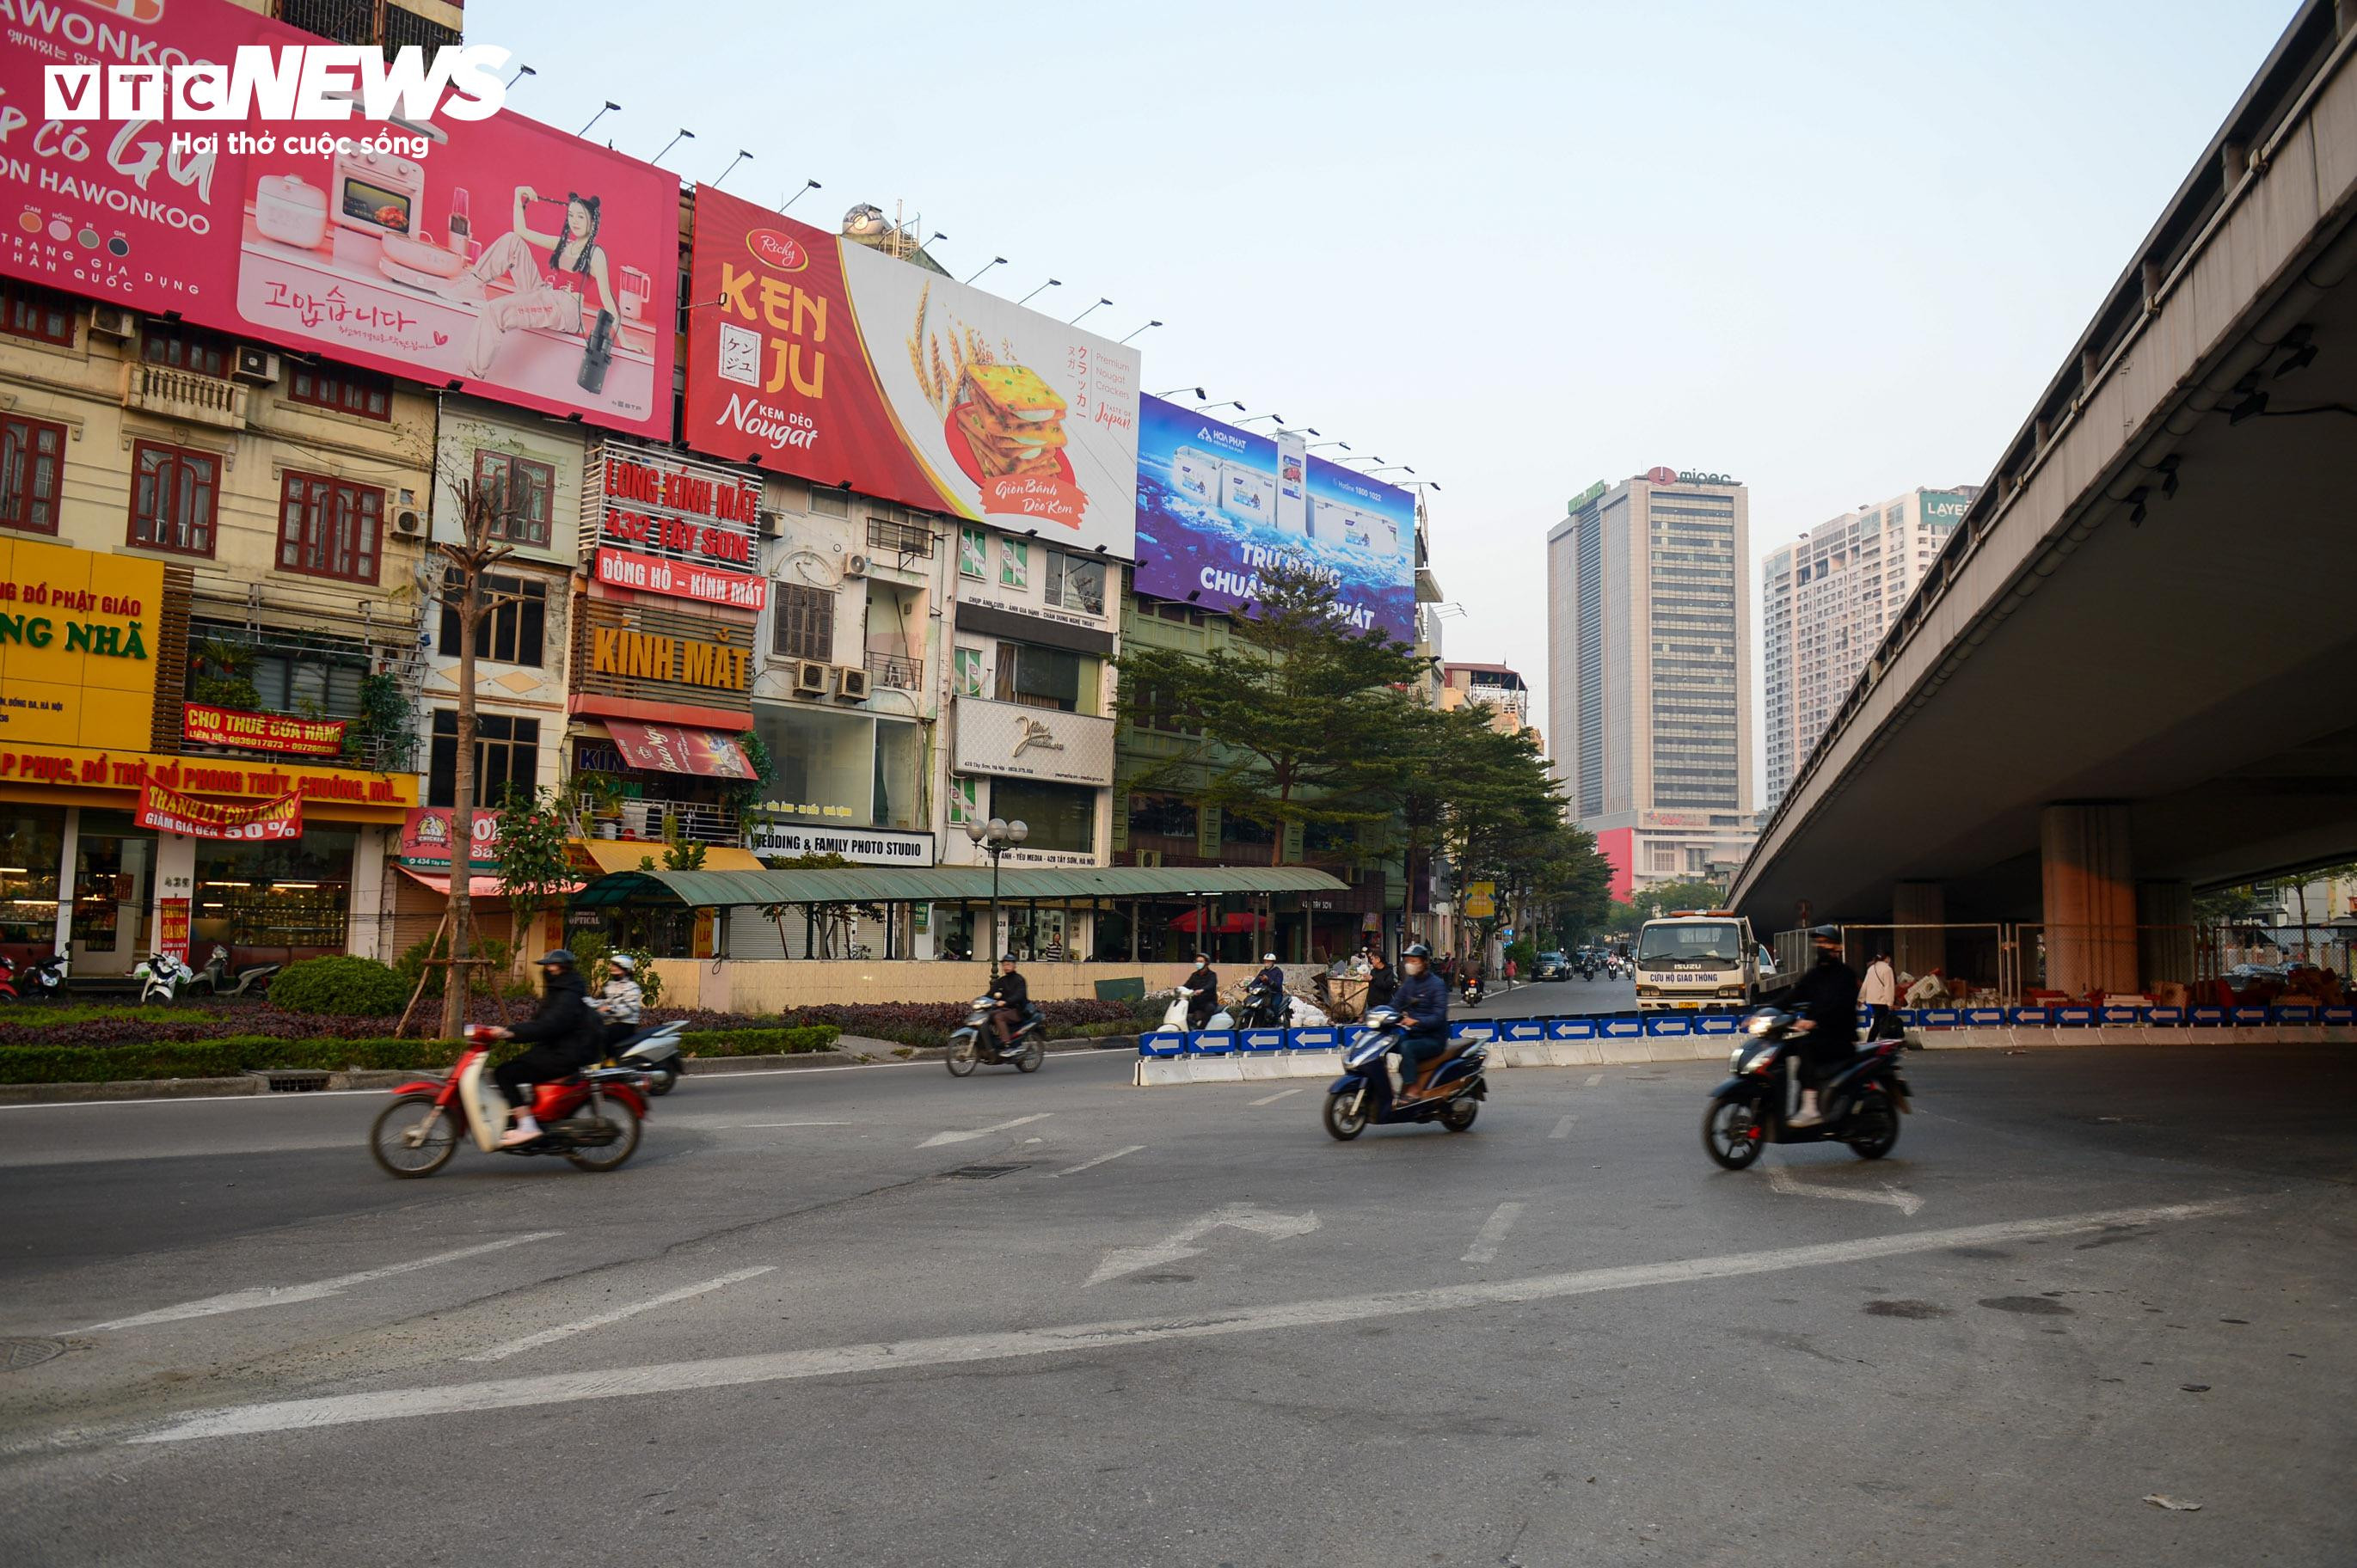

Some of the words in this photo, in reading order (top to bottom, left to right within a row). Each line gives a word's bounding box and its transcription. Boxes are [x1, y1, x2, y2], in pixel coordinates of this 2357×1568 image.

[0, 0, 215, 82] WONKO
[24, 205, 41, 214] CAM
[40, 168, 211, 235] HAWONKOO
[114, 230, 126, 238] GHI
[1, 232, 74, 260] TRANG
[90, 258, 127, 276] GIA
[144, 272, 199, 294] DỤNG
[760, 235, 795, 266] Richy
[13, 253, 57, 272] HÀN
[74, 268, 133, 292] QUỐC
[721, 261, 827, 342] KEN
[727, 337, 754, 354] ケン
[766, 337, 826, 400] JU
[1096, 352, 1130, 372] Premium
[1076, 346, 1088, 419] クラッカー
[1096, 367, 1126, 384] Nougat
[1095, 381, 1130, 400] Crackers
[716, 392, 818, 450] Nougat
[759, 404, 784, 421] KEM
[1095, 401, 1131, 432] Japan
[605, 458, 660, 505] LONG
[663, 466, 713, 516] KÍNH
[715, 475, 758, 524] MẮT
[995, 480, 1024, 499] Giòn
[1024, 478, 1058, 496] Bánh
[1338, 481, 1355, 493] Hotline
[1679, 469, 1732, 487] mipec
[1047, 499, 1073, 515] Kem
[605, 508, 651, 543] 432
[657, 517, 698, 552] TÂY
[701, 527, 750, 562] SƠN
[603, 551, 646, 586] ĐỒNG
[650, 561, 672, 591] HỒ
[691, 572, 727, 600] KÍNH
[730, 578, 763, 606] MẮT
[52, 589, 97, 614] PHẬT
[101, 596, 142, 616] GIÁO
[64, 621, 148, 659] NHÃ
[593, 618, 675, 681] KÍNH
[187, 708, 221, 730] CHO
[226, 714, 266, 735] THUÊ
[269, 719, 301, 739] CỬA
[304, 723, 342, 743] HÀNG
[189, 730, 209, 739] LIÊN
[580, 743, 644, 774] KÍN
[183, 767, 242, 793] PHONG
[149, 786, 198, 819] THANH
[145, 812, 174, 829] GIẢM
[418, 835, 445, 843] CHICKEN
[804, 838, 811, 851] &
[814, 837, 849, 853] FAMILY
[851, 840, 883, 855] PHOTO
[887, 842, 921, 857] STUDIO
[1027, 854, 1042, 863] MEDIA
[1047, 855, 1056, 864] 428
[1057, 854, 1065, 865] TÂY
[569, 916, 600, 925] OPTICAL
[1666, 972, 1675, 984] HỘ
[1677, 973, 1693, 983] GIAO
[1695, 972, 1718, 982] THÔNG
